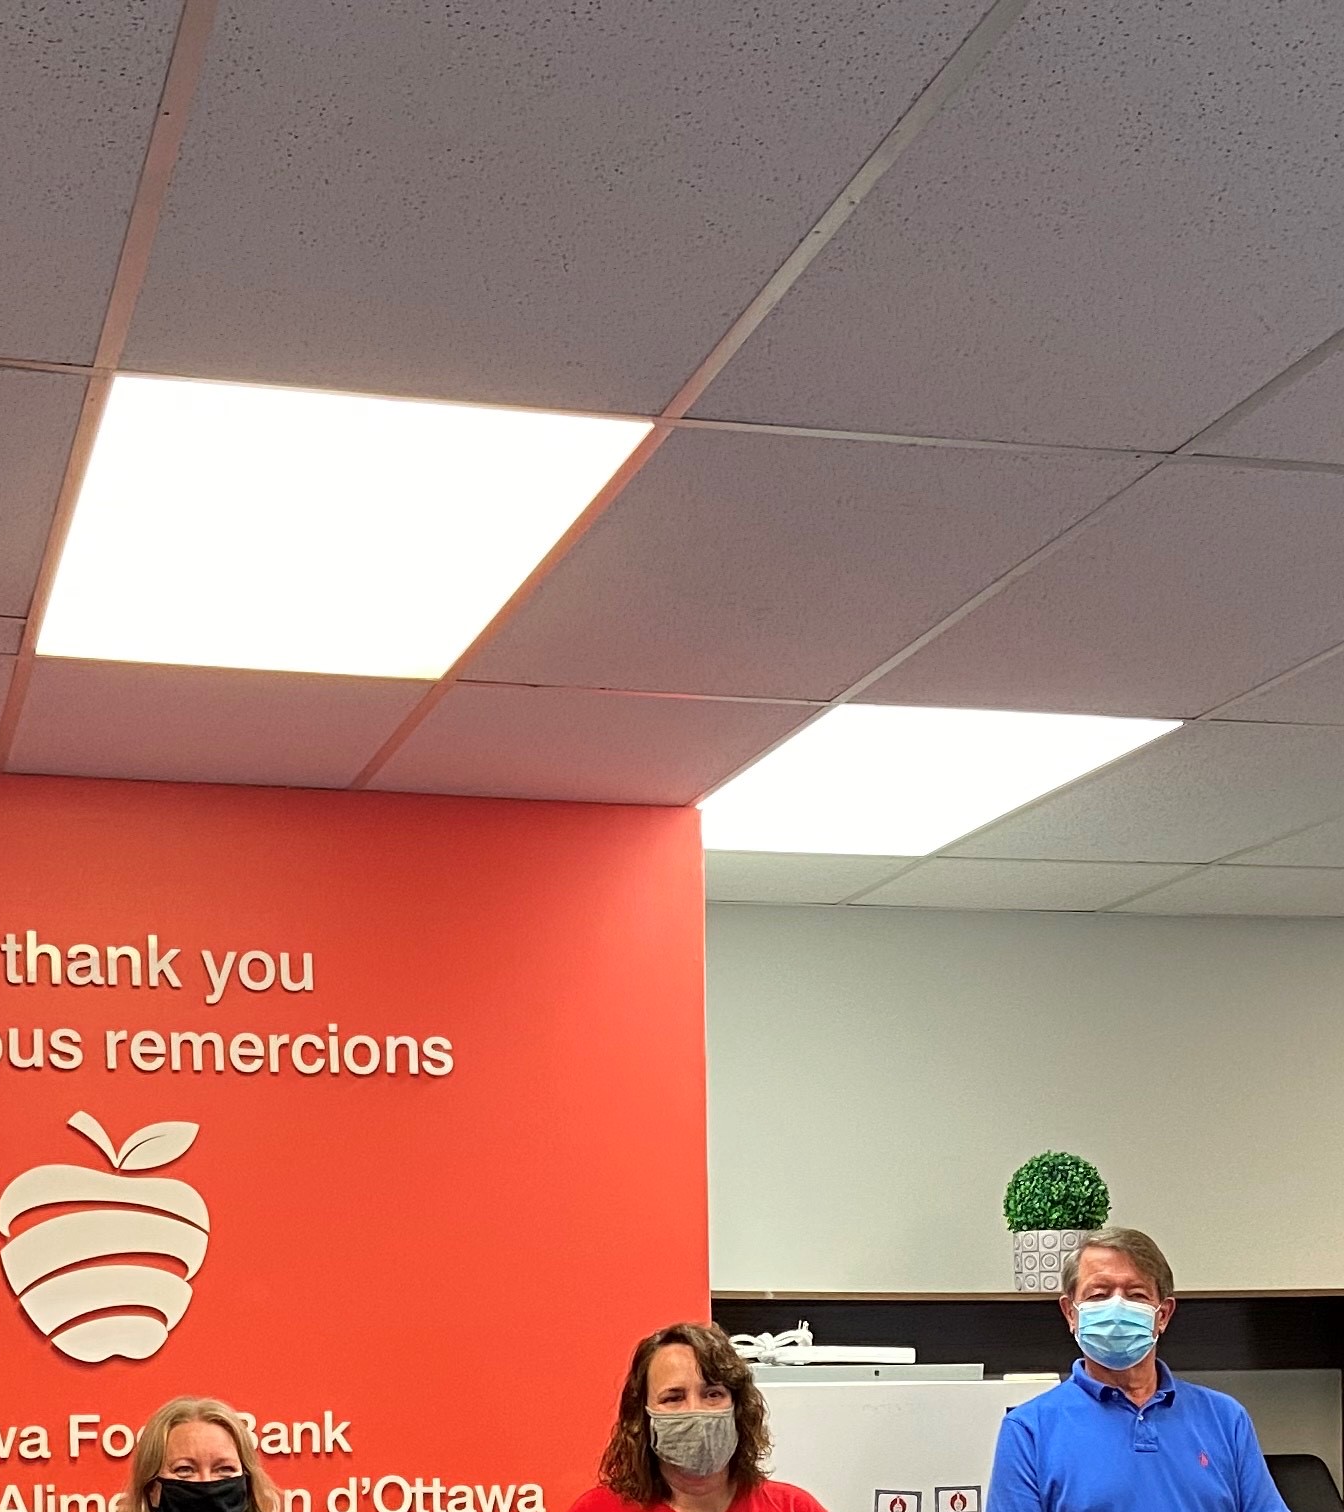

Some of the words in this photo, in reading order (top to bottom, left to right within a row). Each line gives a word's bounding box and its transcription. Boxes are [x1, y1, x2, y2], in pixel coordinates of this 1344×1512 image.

[0, 930, 183, 988] thank
[201, 949, 314, 1005] you
[105, 1023, 454, 1077] remercions
[68, 1413, 148, 1458] Fo
